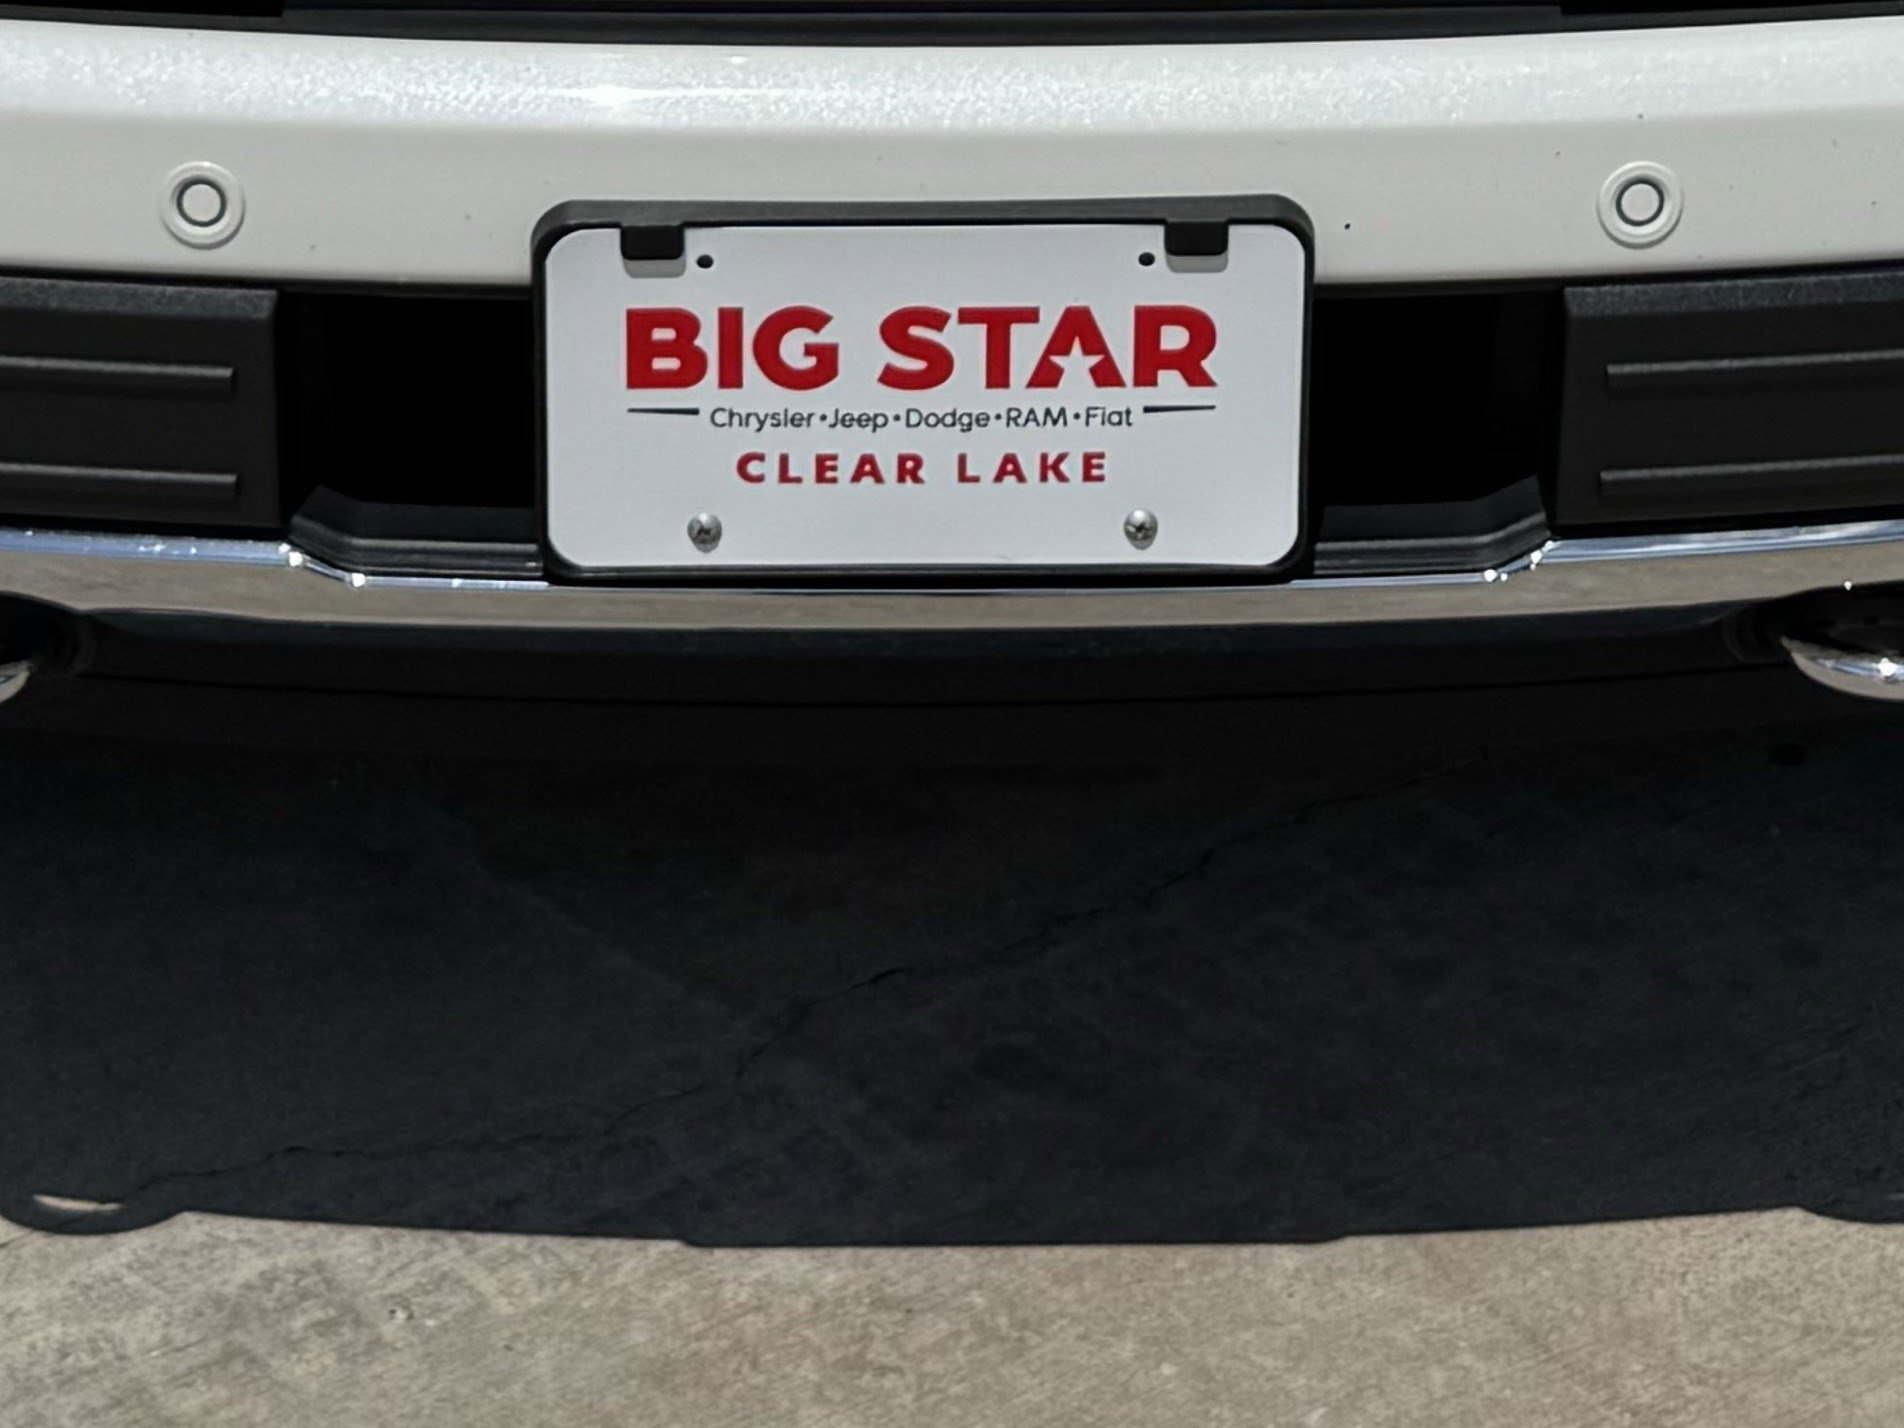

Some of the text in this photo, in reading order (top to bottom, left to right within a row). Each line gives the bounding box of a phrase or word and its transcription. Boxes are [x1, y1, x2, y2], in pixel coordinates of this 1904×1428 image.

[625, 303, 1219, 392] BIG STAR
[709, 405, 1133, 435] Chrysler Jeep Dodge RAM Fiat
[735, 451, 1107, 485] CLEAR LAKE
